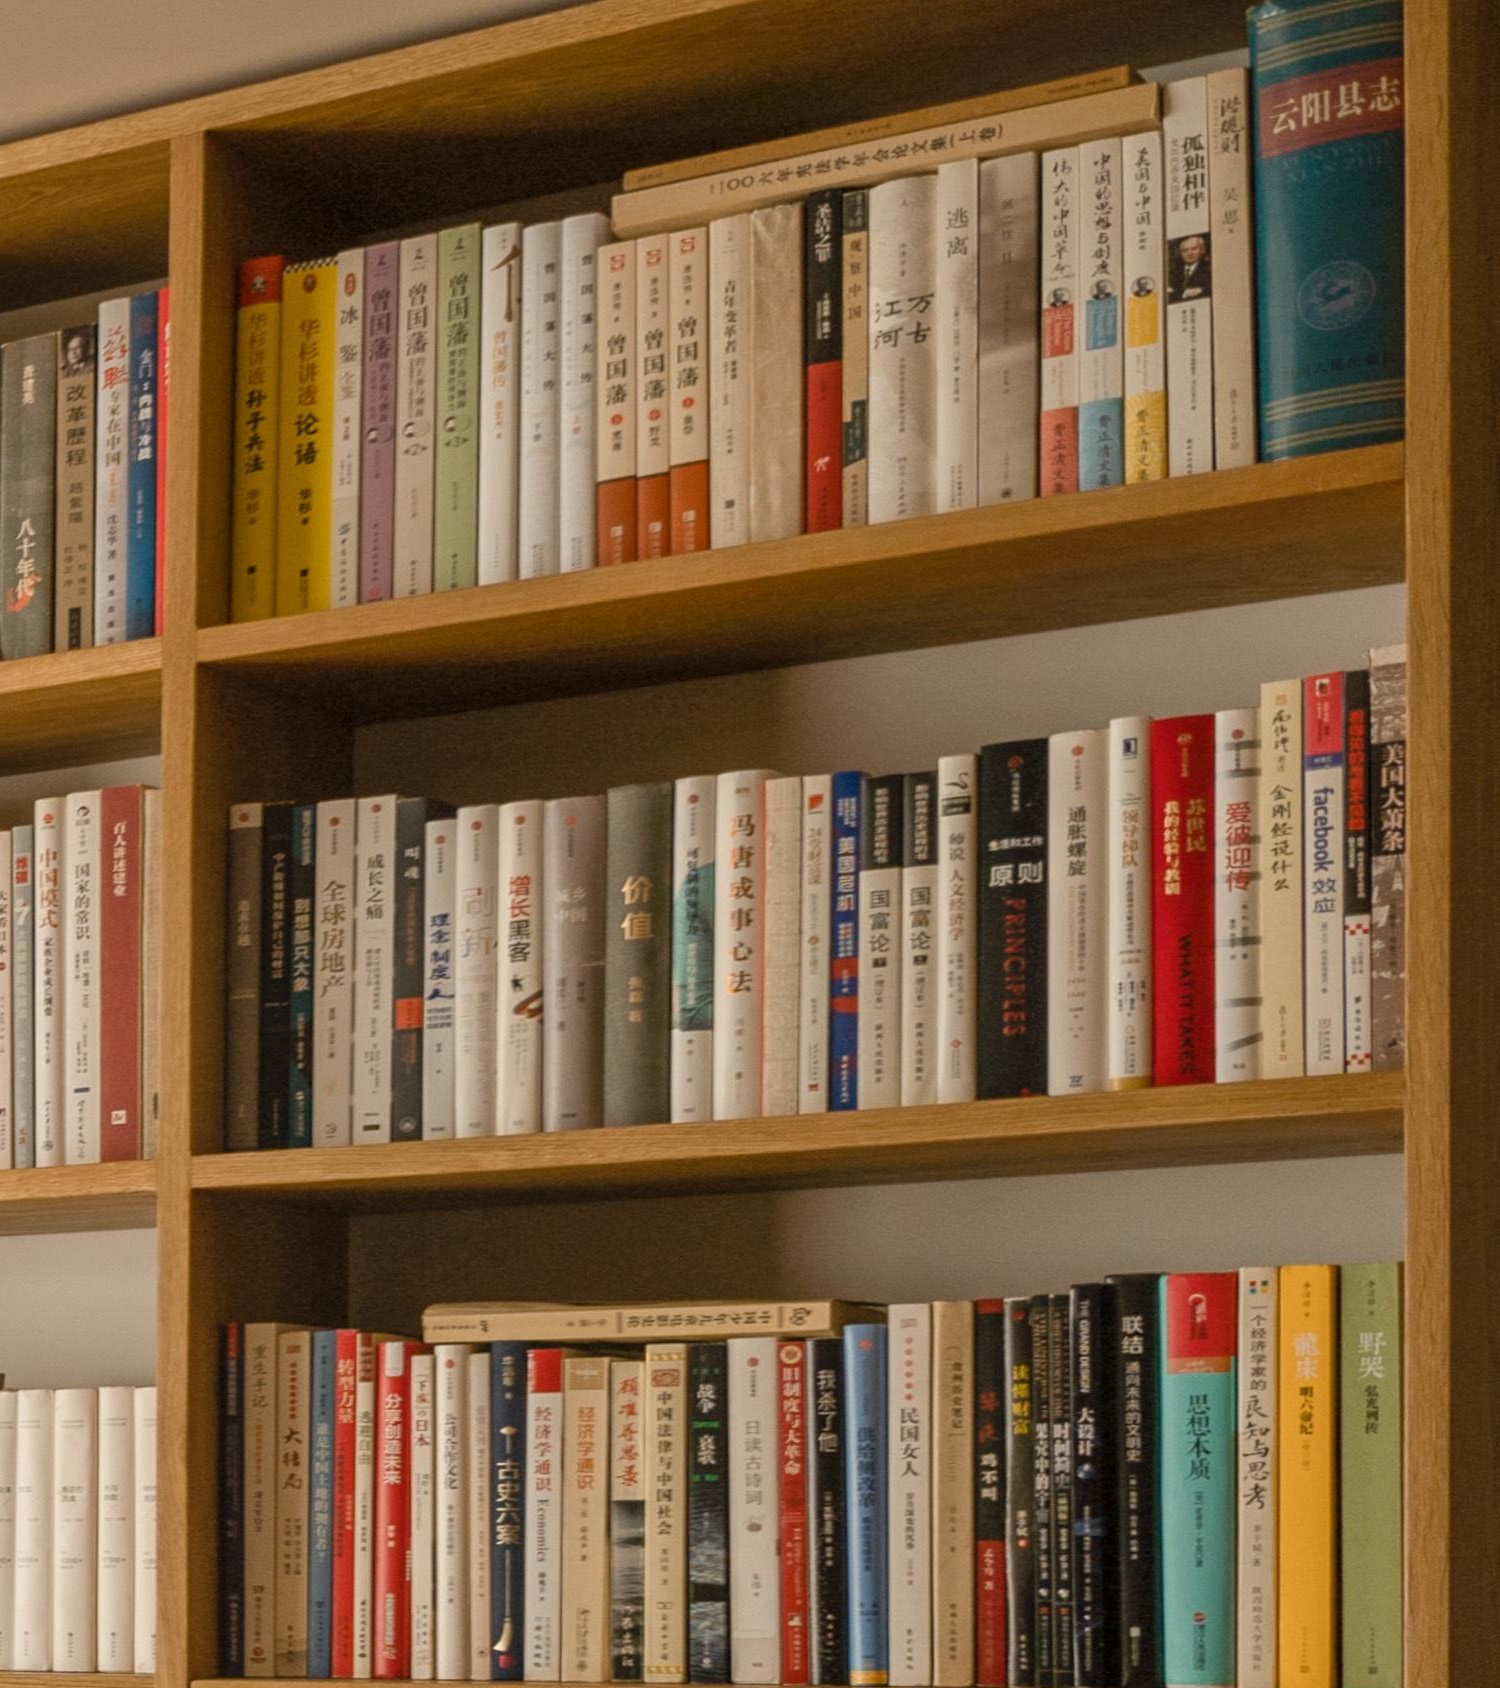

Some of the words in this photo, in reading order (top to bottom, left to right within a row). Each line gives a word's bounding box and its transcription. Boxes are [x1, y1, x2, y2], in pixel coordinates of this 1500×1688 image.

[1270, 76, 1400, 135] 云阳县志
[1182, 135, 1206, 210] 孤独相伴
[947, 207, 969, 258] 逃离
[370, 289, 391, 362] 曾国藩
[407, 283, 428, 355] 曾国藩
[447, 274, 468, 347] 曾国藩
[606, 333, 628, 406] 曾国藩
[644, 328, 665, 401] 曾国藩
[677, 315, 698, 388] 曾国藩
[66, 385, 87, 466] 改革歷程
[14, 519, 36, 598] 八十年代
[1313, 787, 1333, 872] facebook
[1380, 744, 1404, 851] 美国大萧条
[989, 861, 1043, 887] 原则
[1067, 806, 1087, 876] 通胀螺旋
[1225, 802, 1251, 892] 爱彼迎传
[38, 849, 58, 929] 中国模式
[74, 862, 90, 940] 国家的常识
[366, 853, 384, 921] 成长之痛
[509, 874, 530, 963] 增长黑客
[620, 875, 652, 941] 价值
[727, 813, 755, 993] 冯唐成事心法
[869, 889, 890, 953] 国富论
[910, 886, 931, 951] 国富论
[1312, 877, 1336, 915] 效应
[320, 880, 346, 999] 全球房地产
[1121, 1316, 1144, 1354] 联结
[1249, 1305, 1268, 1391] 一个经济学家的
[1357, 1332, 1386, 1378] 野哭
[337, 1359, 354, 1423] 转型力量
[782, 1367, 801, 1476] 旧制度与大革命
[817, 1370, 839, 1453] 我杀了他
[383, 1393, 402, 1486] 分享创造未来
[534, 1407, 552, 1492] 经济学通识
[576, 1407, 595, 1490] 经济学通识
[744, 1420, 763, 1506] 日读古诗词
[900, 1408, 919, 1477] 民国女人
[1077, 1408, 1095, 1456] 大设计
[1185, 1394, 1212, 1482] 思想本质
[495, 1461, 520, 1546] 古史六案
